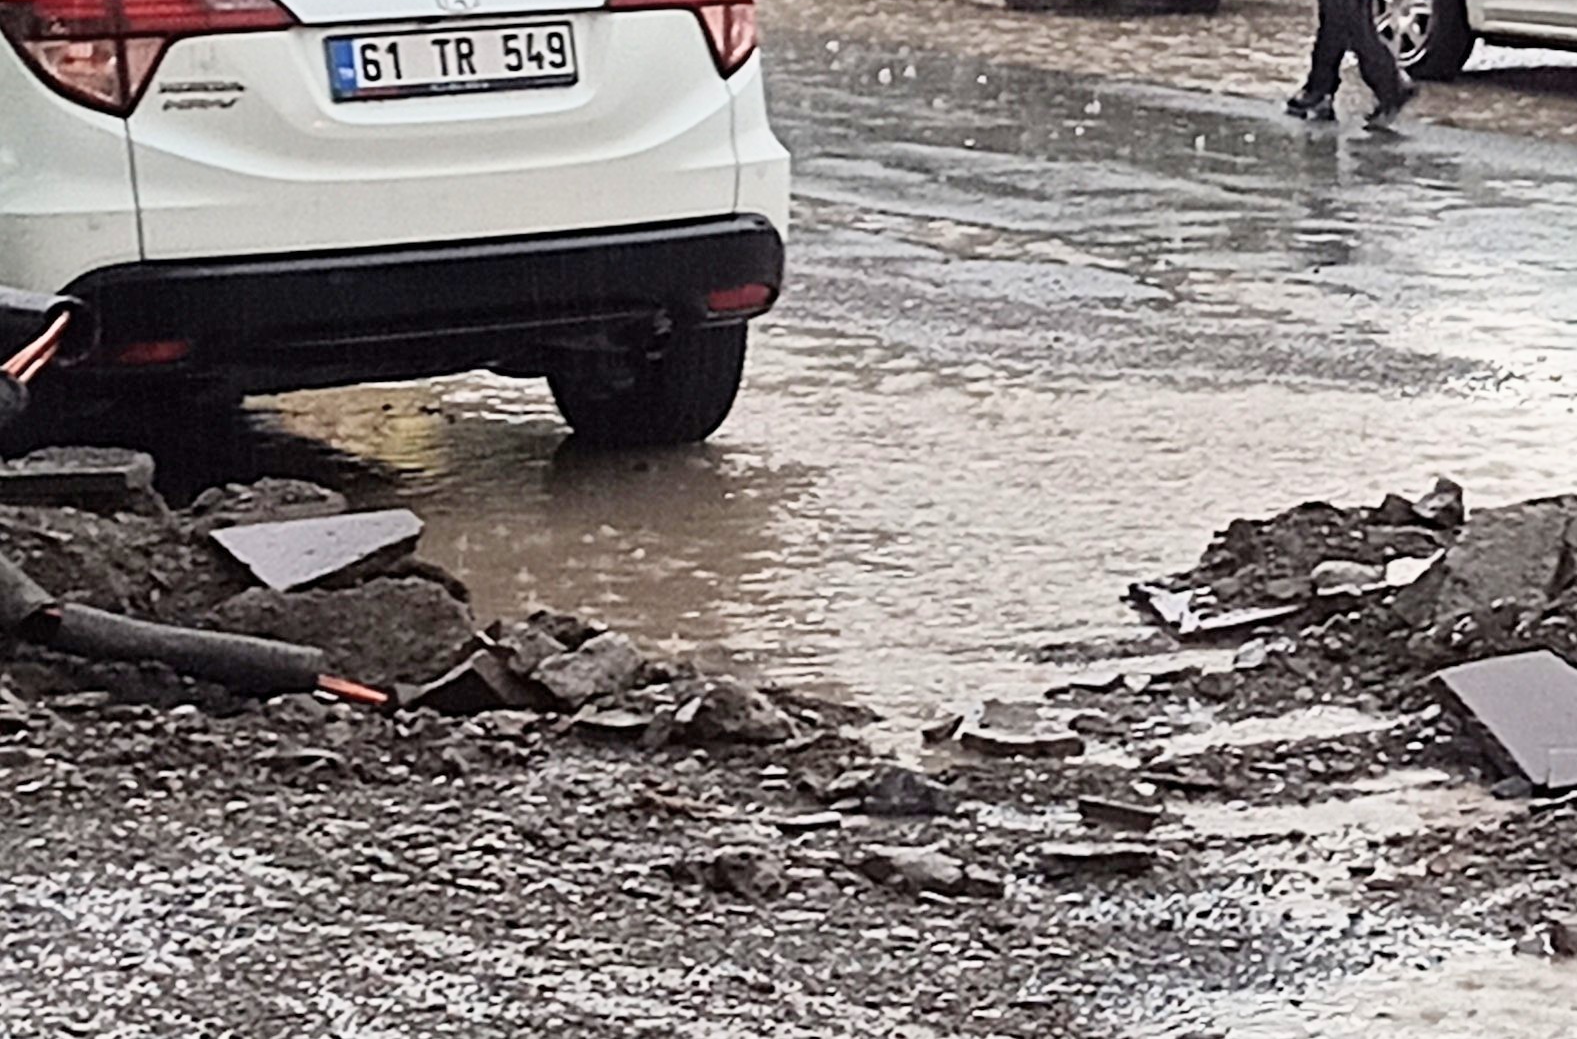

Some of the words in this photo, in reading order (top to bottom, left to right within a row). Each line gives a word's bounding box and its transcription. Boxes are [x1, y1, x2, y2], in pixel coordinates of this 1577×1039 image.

[360, 42, 402, 81] 61
[431, 37, 476, 76] TR
[501, 32, 567, 72] 549
